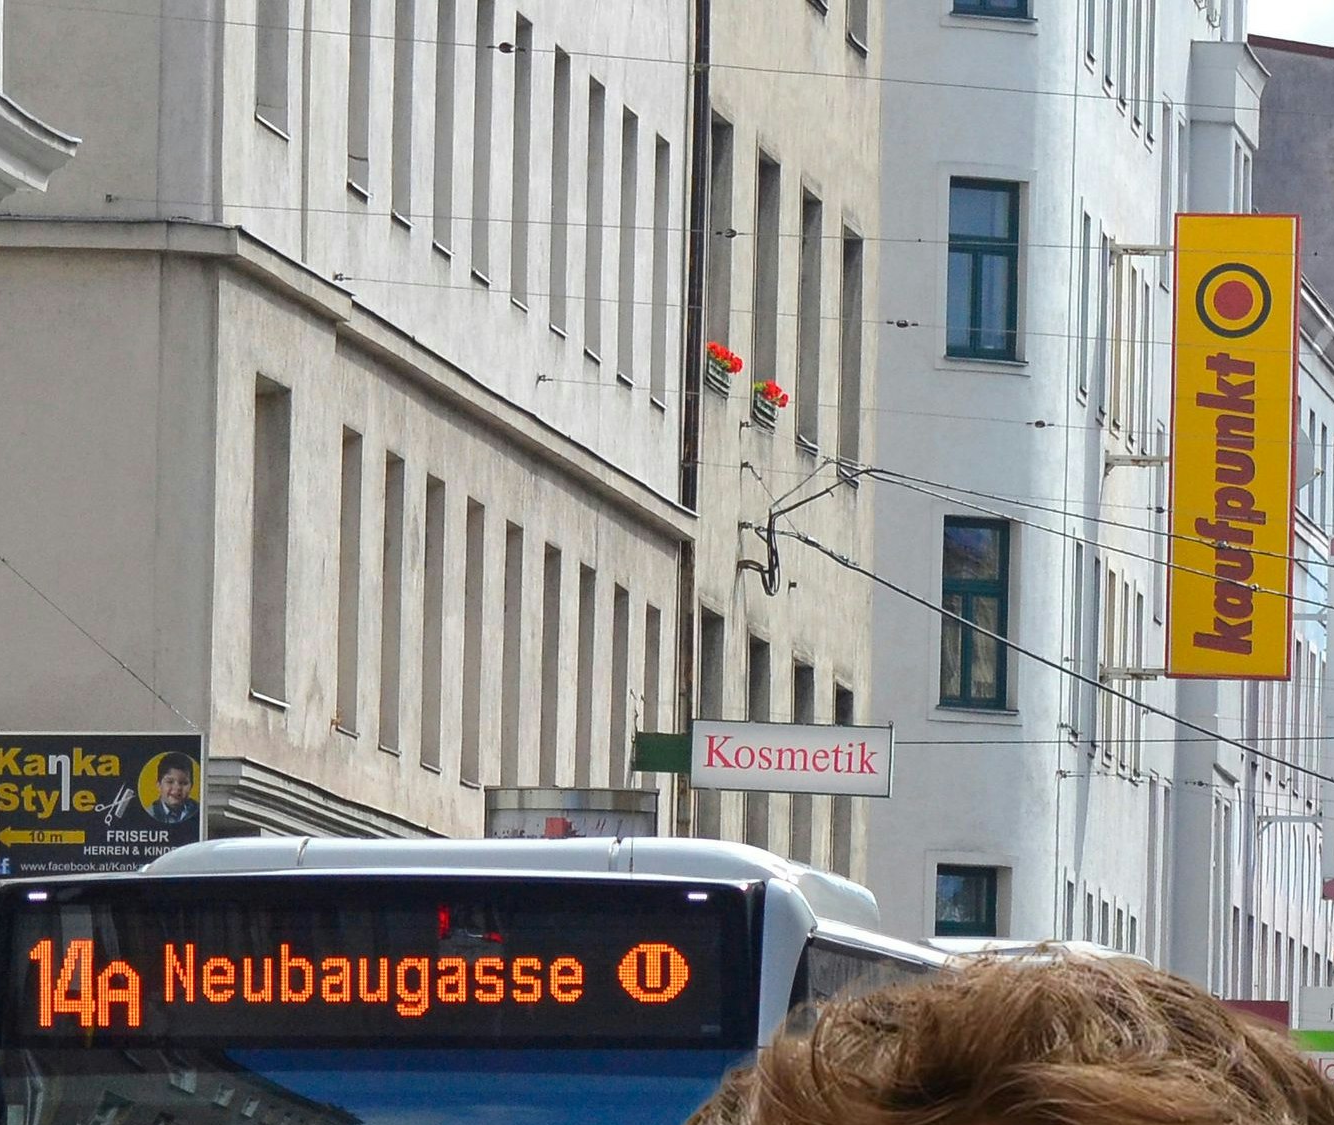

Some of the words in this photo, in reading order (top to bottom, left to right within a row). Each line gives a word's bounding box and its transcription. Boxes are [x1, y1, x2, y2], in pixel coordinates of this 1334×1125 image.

[1193, 352, 1267, 655] kaufpunkt
[703, 734, 879, 775] Kosmetik
[30, 831, 47, 843] 10
[51, 833, 63, 842] m
[106, 830, 169, 843] FRISEUR
[83, 846, 130, 856] HERREN
[132, 846, 140, 856] &
[29, 938, 141, 1028] 14A
[163, 943, 584, 1016] Neubaugasse
